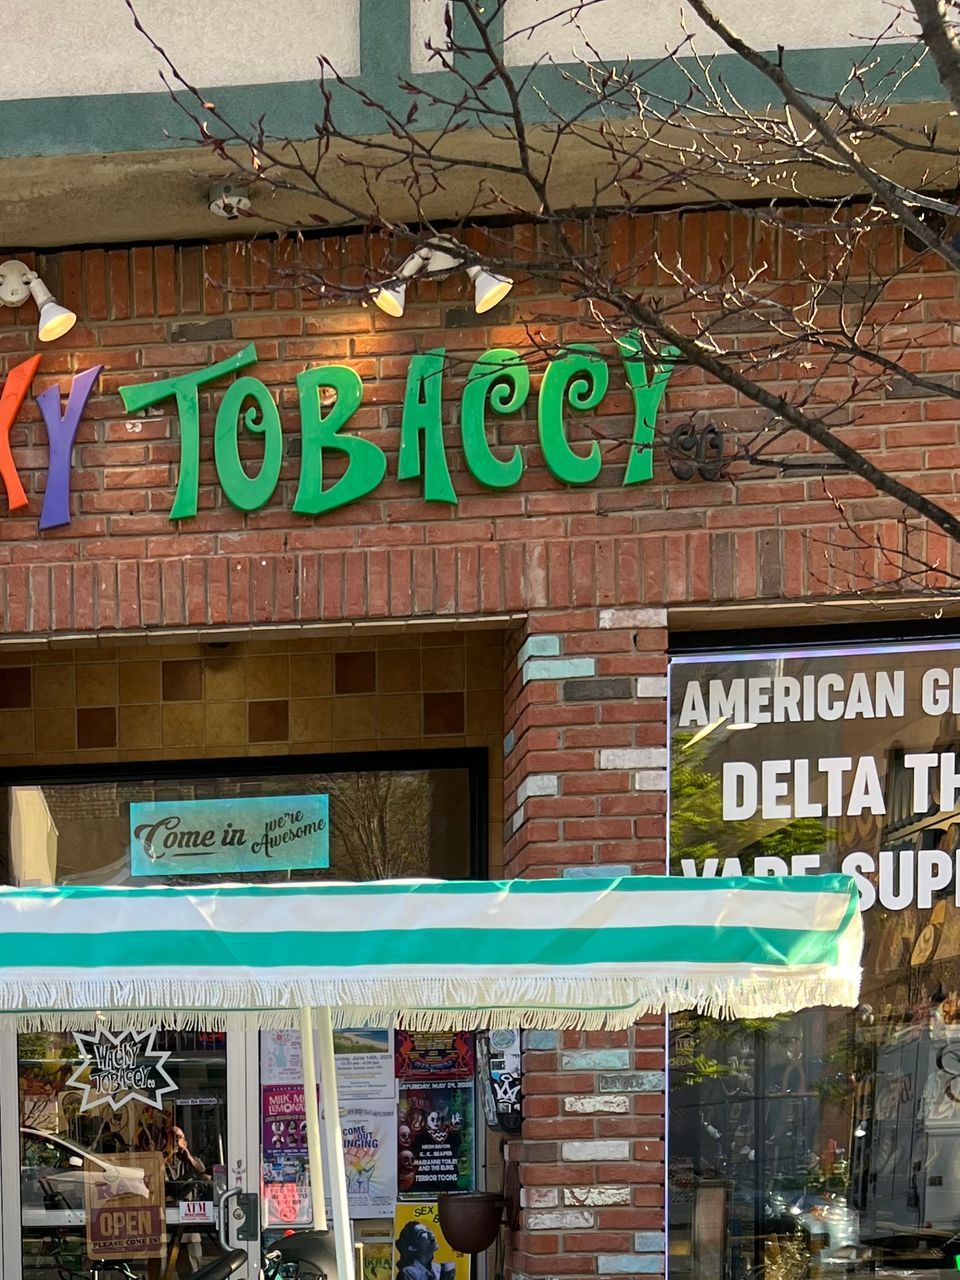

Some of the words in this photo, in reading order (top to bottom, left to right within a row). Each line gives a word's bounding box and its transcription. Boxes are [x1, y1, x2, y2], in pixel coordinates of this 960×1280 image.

[118, 328, 682, 521] TOBACCY
[678, 671, 905, 728] AMERICAN
[922, 668, 960, 716] G
[722, 756, 886, 821] DELTA
[134, 816, 215, 859] Come
[221, 823, 247, 847] in
[251, 817, 326, 858] Awesome
[93, 1041, 142, 1073] WACKY
[90, 1065, 152, 1095] TOBACCY
[342, 1125, 366, 1136] COME
[343, 1139, 378, 1148] INGING
[357, 1132, 373, 1140] OUT
[185, 1202, 206, 1213] ATM
[414, 1206, 434, 1217] SEX
[100, 1210, 152, 1236] OPEN
[93, 1240, 124, 1248] PLEASE
